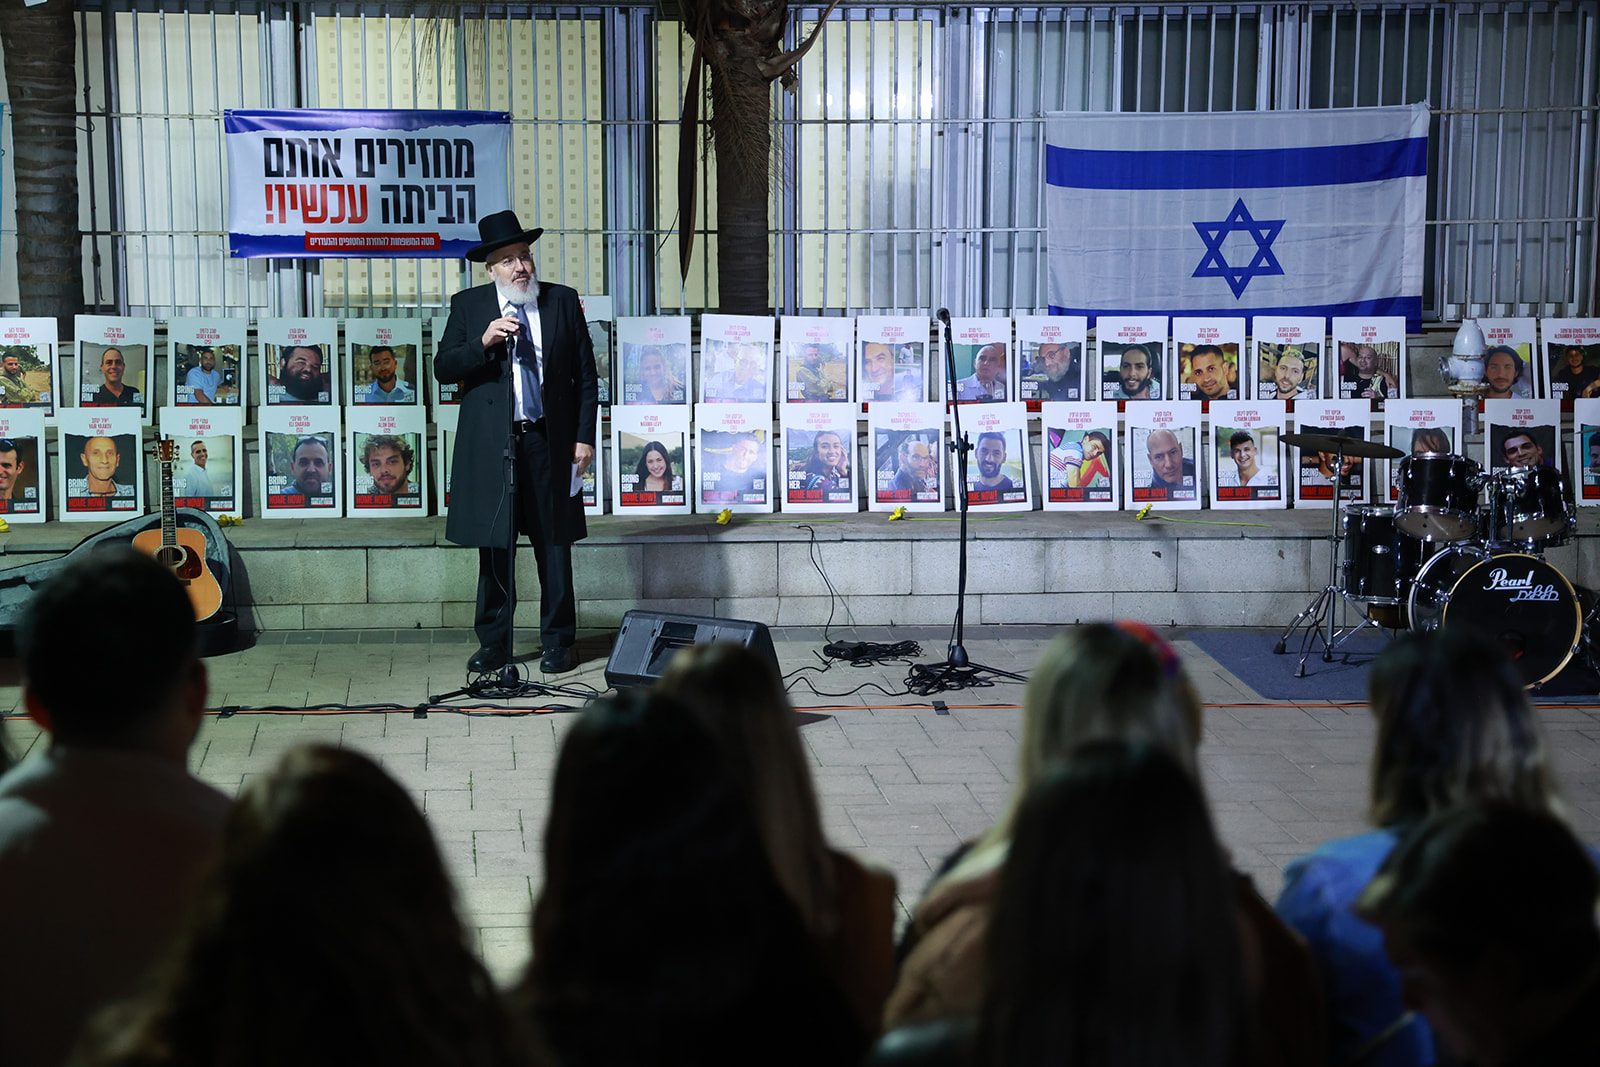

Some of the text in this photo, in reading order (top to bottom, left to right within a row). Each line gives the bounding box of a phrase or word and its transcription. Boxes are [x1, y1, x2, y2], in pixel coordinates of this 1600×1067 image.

[264, 138, 475, 178] מחזירים אותם
[265, 184, 476, 224] הביתה עכשיו!
[173, 479, 187, 488] RING
[1483, 568, 1534, 590] Pearl
